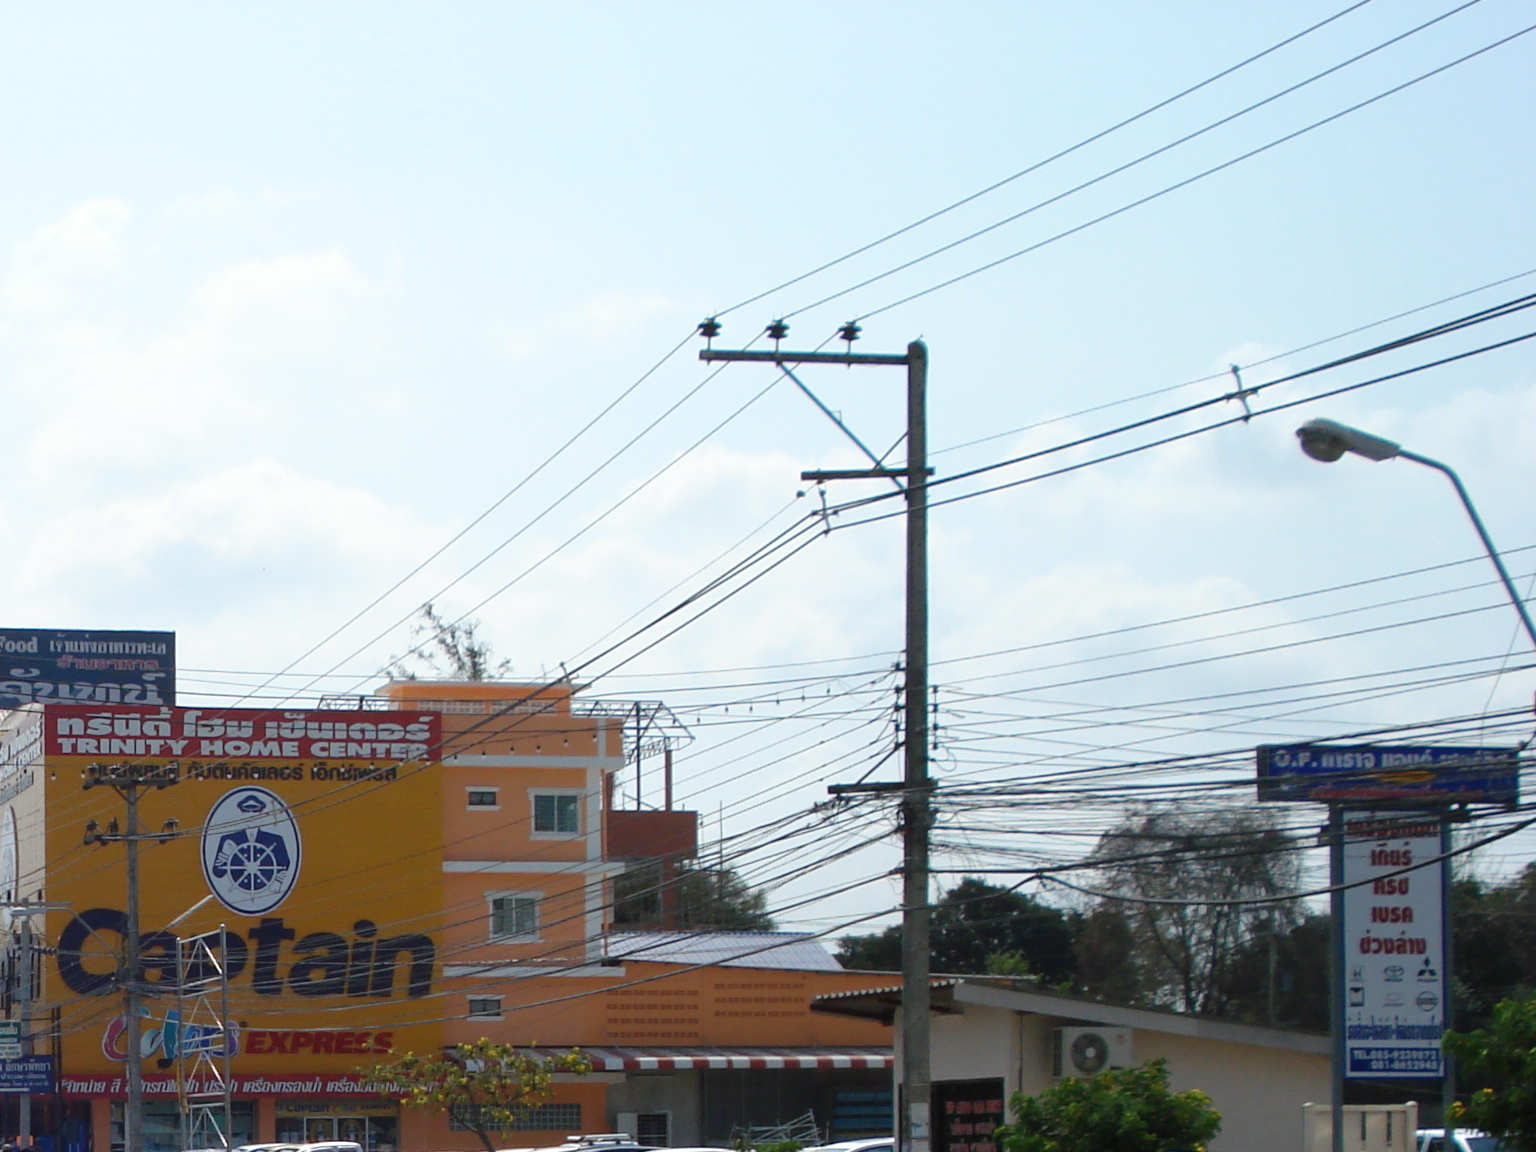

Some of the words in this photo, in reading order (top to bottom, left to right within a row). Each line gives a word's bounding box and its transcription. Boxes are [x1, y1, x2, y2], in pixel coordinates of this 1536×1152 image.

[184, 709, 254, 738] โฮม
[56, 737, 191, 756] TRINITY
[199, 740, 300, 758] HOME
[309, 741, 430, 760] CENTER
[57, 907, 436, 998] Captain
[245, 1031, 394, 1054] EXPRESS
[110, 1078, 122, 1093] สี
[243, 1076, 321, 1093] เครื่องกรองน้ำ
